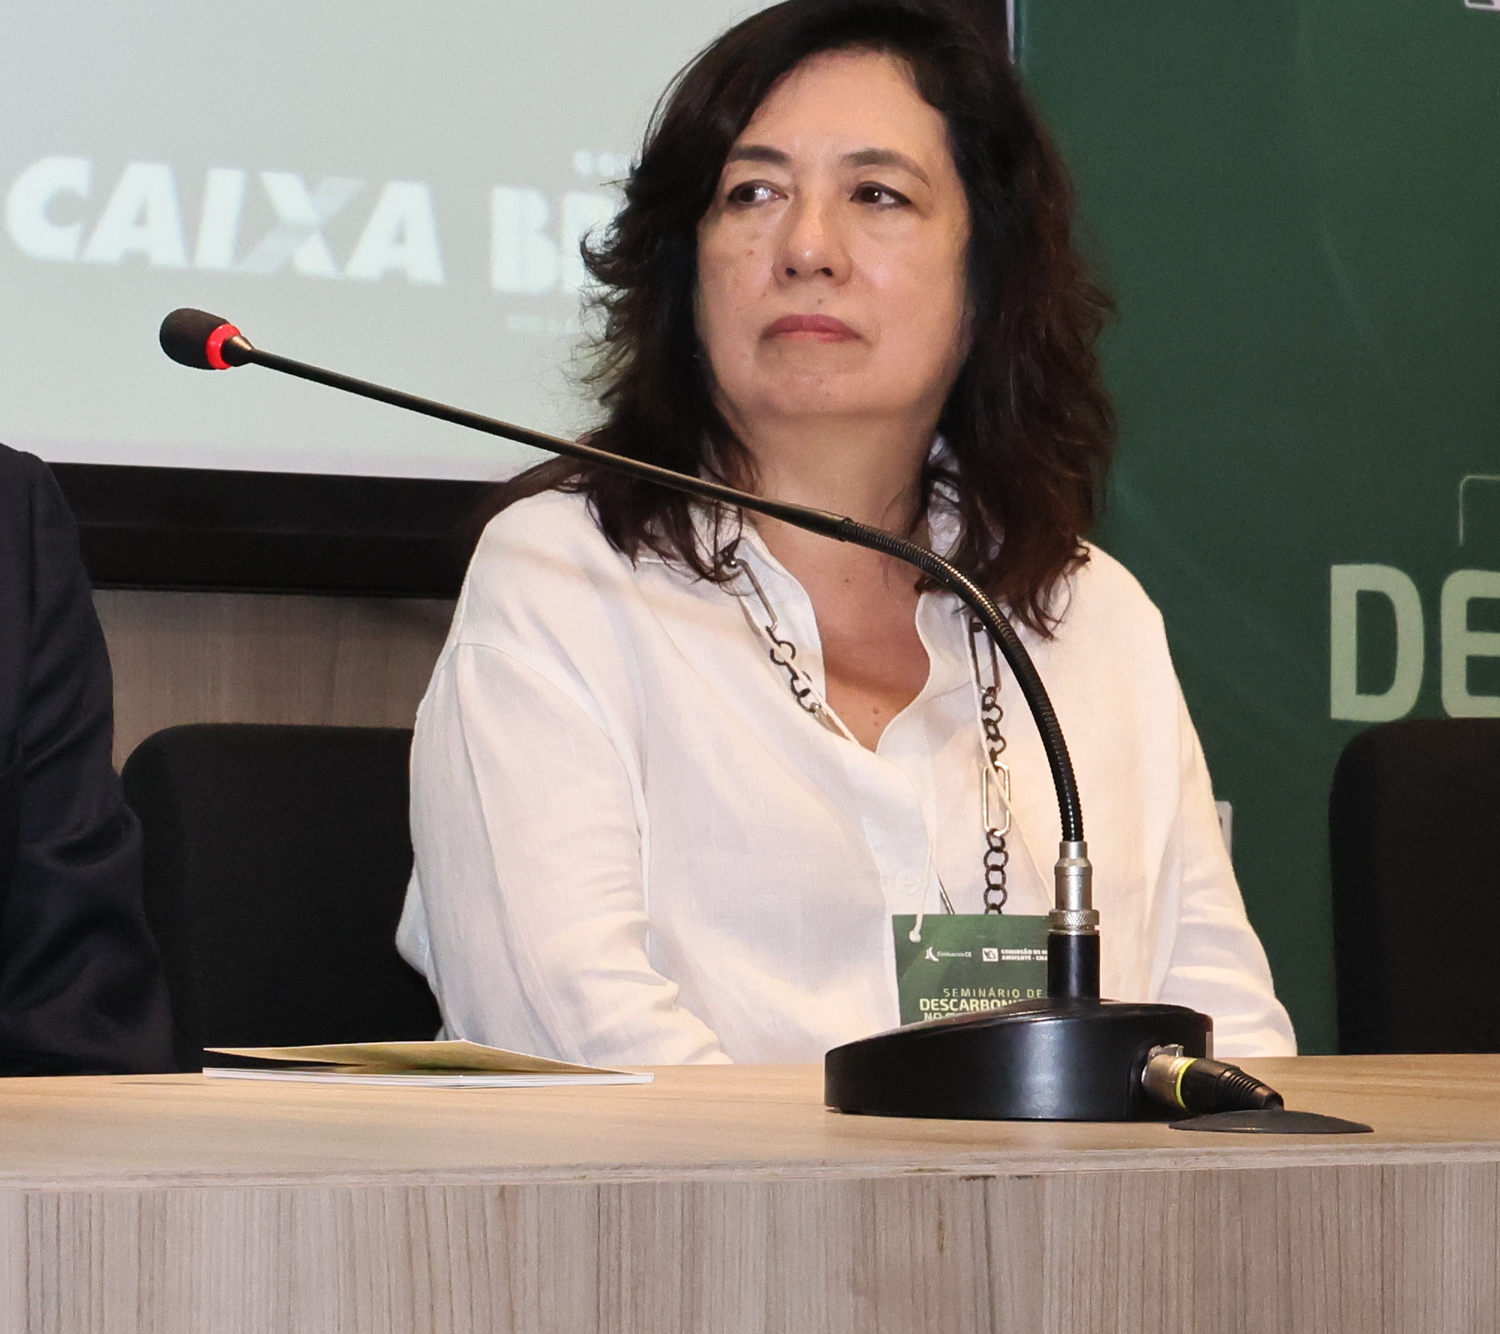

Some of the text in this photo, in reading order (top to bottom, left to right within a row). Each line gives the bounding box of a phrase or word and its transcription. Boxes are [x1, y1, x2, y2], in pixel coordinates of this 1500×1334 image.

[4, 154, 447, 287] CAIXA
[943, 987, 1043, 998] SEMINÁRIO DE
[919, 998, 1025, 1011] DESCARBO
